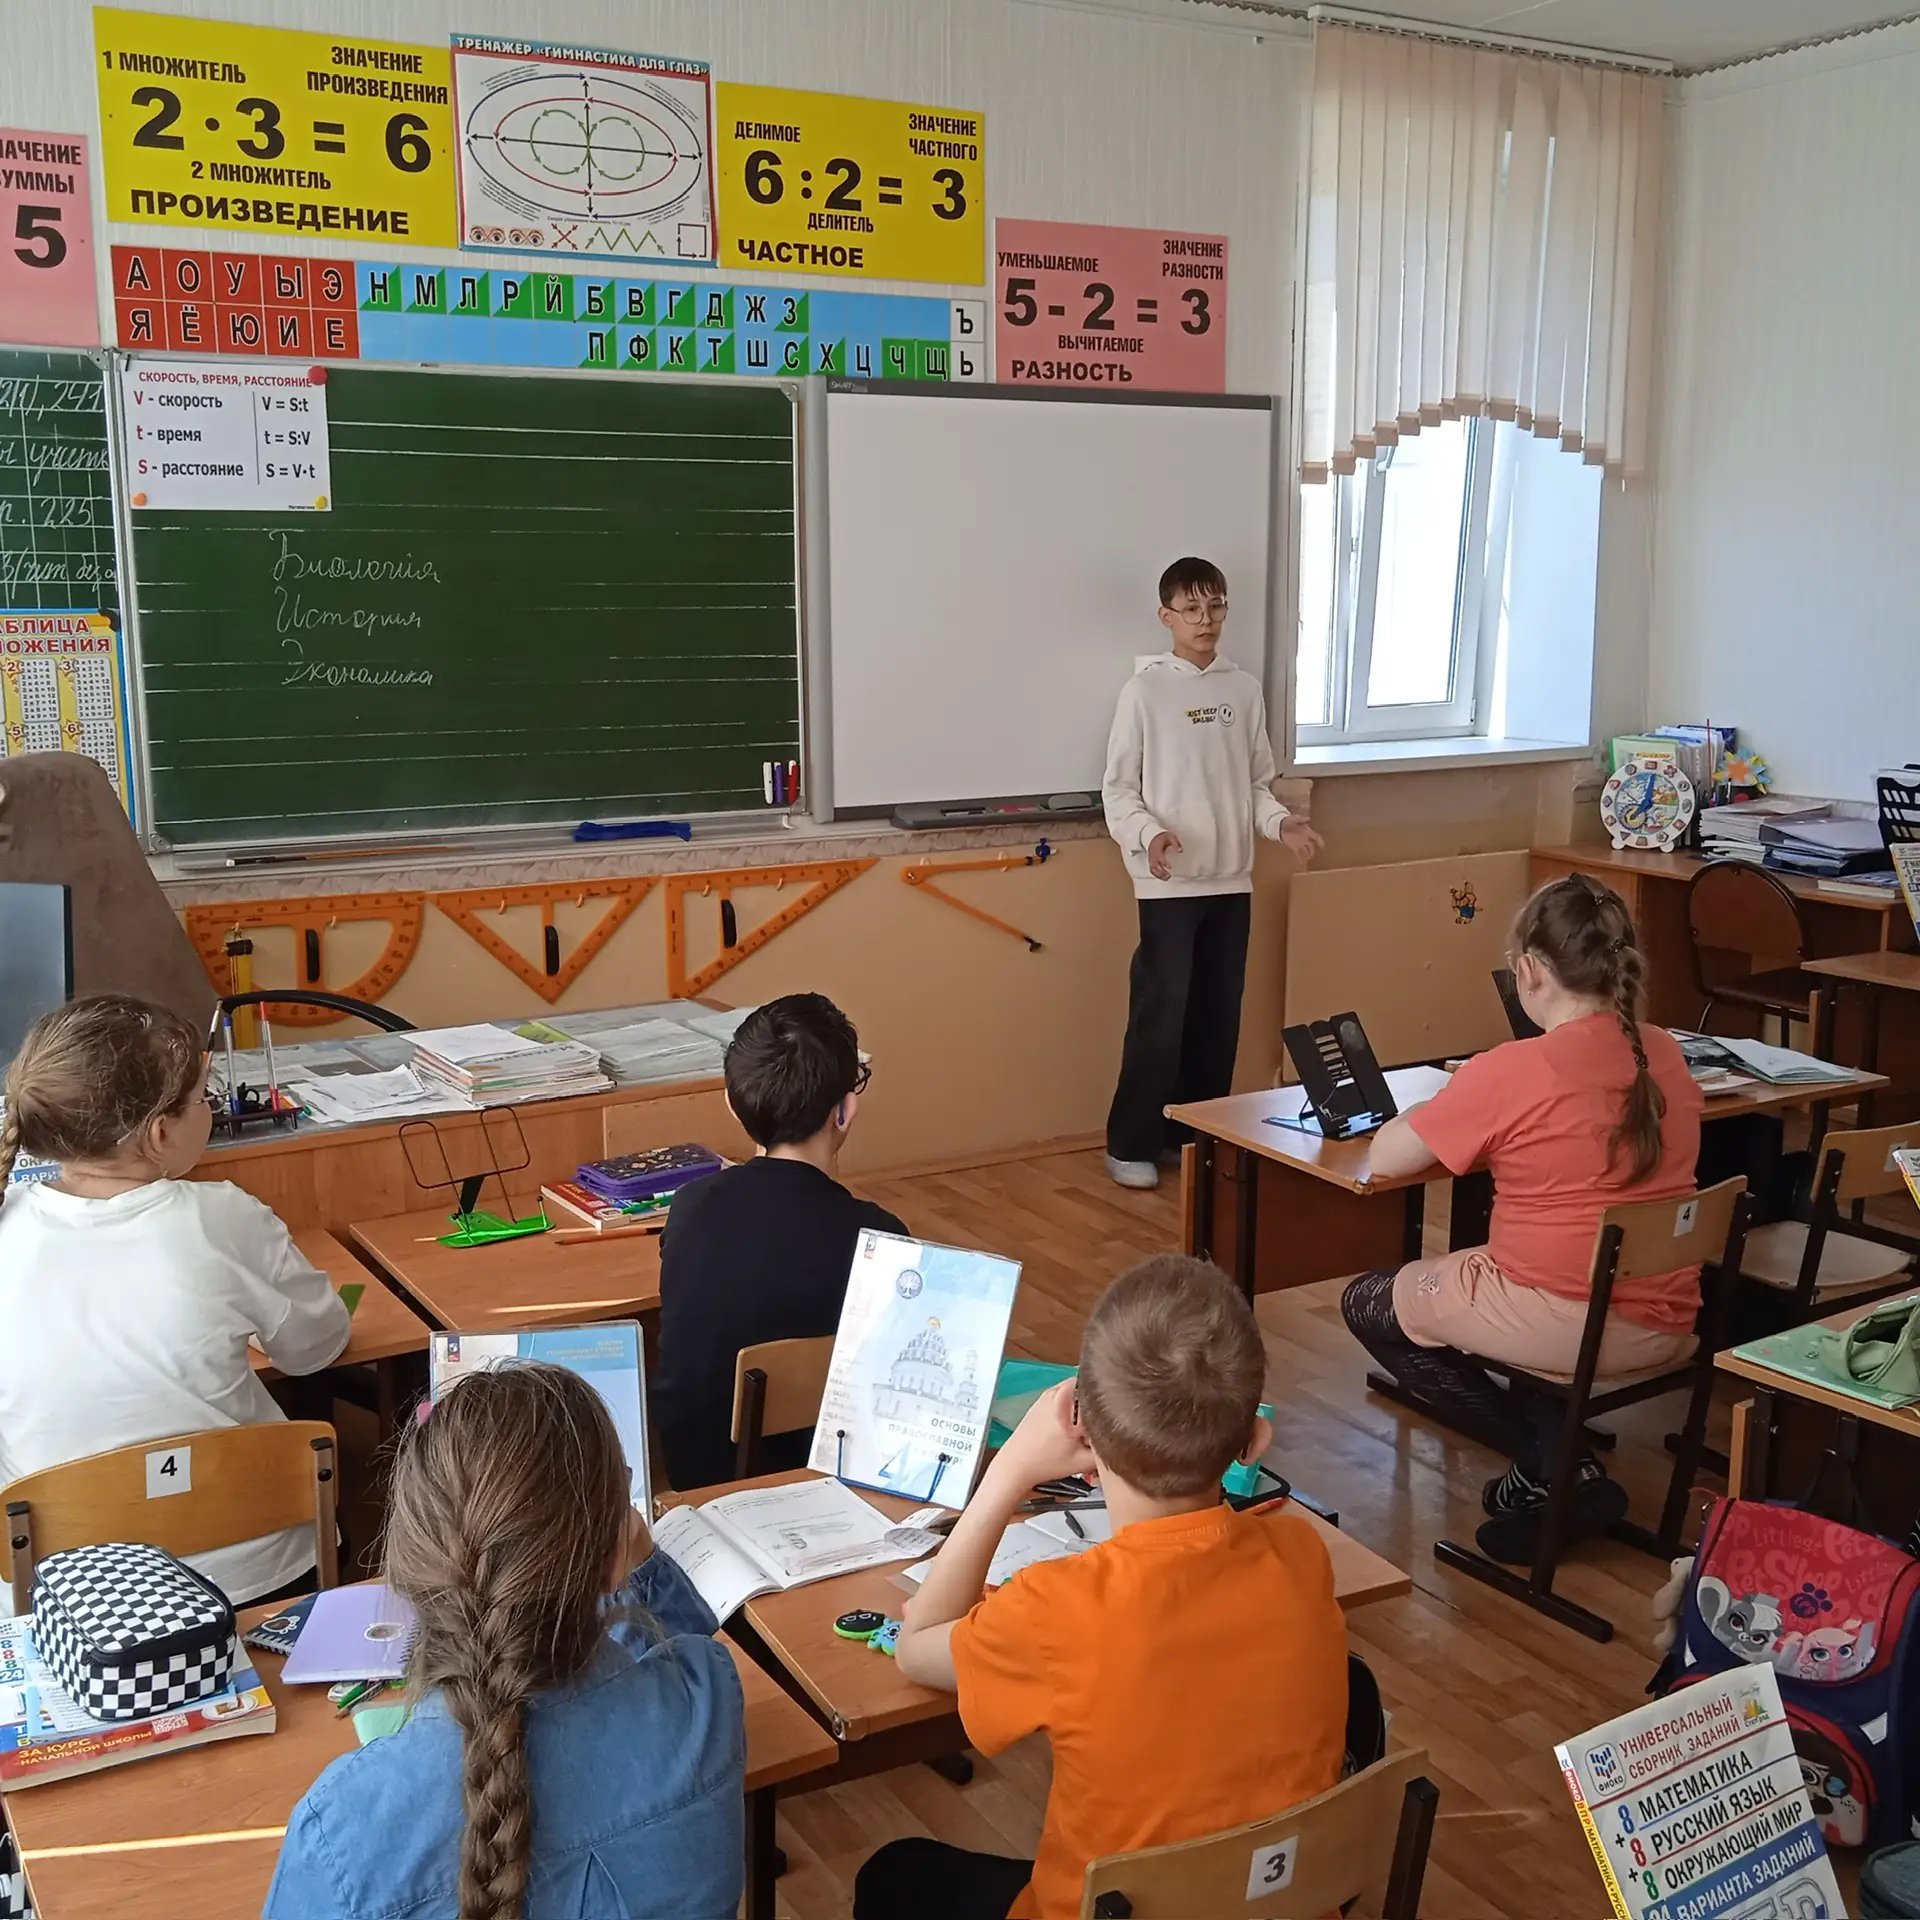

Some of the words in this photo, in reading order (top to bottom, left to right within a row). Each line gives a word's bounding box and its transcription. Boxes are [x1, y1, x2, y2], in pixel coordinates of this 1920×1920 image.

[103, 51, 112, 69] 1
[119, 52, 246, 83] МНОЖИТЕЛЬ
[332, 46, 422, 73] ЗНАЧЕНИЕ
[639, 57, 666, 71] ДЛЯ
[307, 71, 447, 104] ПРОИЗВЕДЕНИЯ
[132, 87, 184, 150] 2
[236, 98, 284, 159] 3
[386, 113, 431, 172] 6
[735, 121, 800, 142] ДЕЛИМОЕ
[909, 113, 976, 136] ЗНАЧЕНИЕ
[909, 138, 977, 160] ЧАСТНОГО
[0, 169, 74, 194] УММЫ
[191, 161, 204, 179] 2
[210, 163, 331, 189] МНОЖИТЕЛЬ
[745, 150, 783, 204] 6
[825, 159, 861, 211] 2
[932, 169, 966, 220] 3
[131, 190, 409, 234] ПРОИЗВЕДЕНИЕ
[808, 213, 873, 232] ДЕЛИТЕЛЬ
[14, 205, 66, 268] 5
[739, 239, 863, 268] ЧАСТНОЕ
[1164, 240, 1222, 258] ЗНАЧЕНИЕ
[998, 252, 1098, 272] УМЕНЬШАЕМОЕ
[1163, 262, 1223, 280] РАЗНОСТИ
[127, 255, 150, 290] А
[178, 259, 199, 292] О
[223, 262, 246, 295] У
[275, 265, 302, 298] Ы
[322, 269, 344, 300] Э
[370, 271, 389, 304] Н
[414, 274, 436, 306] М
[459, 277, 477, 308] Л
[502, 280, 519, 310] Р
[544, 275, 562, 314] Й
[587, 285, 604, 314] Б
[628, 288, 644, 317] В
[668, 289, 681, 318] Г
[707, 293, 724, 327] Д
[745, 294, 766, 323] Ж
[782, 297, 797, 325] З
[956, 308, 973, 335] Ъ
[1004, 278, 1037, 326] 5
[1083, 283, 1114, 330] 2
[1181, 289, 1210, 335] 3
[130, 310, 152, 340] Я
[182, 306, 201, 342] Ё
[231, 312, 259, 345] Ю
[279, 317, 298, 348] И
[326, 319, 346, 349] Е
[588, 332, 605, 361] П
[628, 335, 649, 362] Ф
[668, 338, 684, 364] К
[707, 338, 722, 366] Т
[746, 340, 768, 367] Ш
[783, 341, 799, 369] С
[820, 342, 834, 371] Х
[856, 344, 871, 379] Ц
[890, 344, 905, 373] Ч
[924, 347, 947, 380] Щ
[960, 350, 974, 375] Ь
[1059, 335, 1143, 352] ВЫЧИТАЕМОЕ
[139, 371, 199, 386] СКОРОСТЬ,
[202, 374, 242, 387] ВРЕМЯ,
[244, 376, 313, 388] РАССТОЯНИЕ
[1012, 360, 1132, 381] РАЗНОСТЬ
[133, 391, 144, 405] V
[158, 394, 223, 410] скорость
[261, 397, 272, 411] V
[136, 425, 143, 440] t
[157, 428, 202, 444] время
[264, 430, 271, 445] t
[138, 459, 148, 475] S
[162, 461, 244, 479] расстояние
[266, 463, 275, 478] S
[40, 497, 92, 529] 225
[274, 585, 421, 636] История
[0, 618, 90, 636] БЛИЦА
[0, 638, 110, 654] ОЖЕНИЯ
[7, 661, 16, 672] 2
[63, 660, 71, 671] 3
[281, 638, 434, 686] Экономика
[13, 726, 21, 737] 5
[67, 723, 76, 734] 6
[1682, 1206, 1691, 1221] 4
[931, 1418, 976, 1437] ОСНОВЫ
[160, 1455, 178, 1478] 4
[1619, 1693, 1734, 1759] УНИВЕРСАЛЬНЫЙ
[19, 1748, 42, 1758] ЗА
[46, 1738, 92, 1754] КУРС
[20, 1744, 101, 1766] НАЧАЛЬНОЙ
[103, 1731, 153, 1748] ШКОЛЫ
[1628, 1743, 1684, 1780] СБОРНИК
[1686, 1715, 1741, 1751] ЗАДАНИЙ
[1598, 1774, 1624, 1792] ФИОКО
[1617, 1803, 1635, 1835] 8
[1638, 1750, 1754, 1823] МАТЕМАТИКА
[1629, 1837, 1647, 1867] 8
[1651, 1794, 1728, 1856] РУССКИЙ
[1730, 1775, 1779, 1814] ЯЗЫК
[1586, 1827, 1615, 1888] МАТЕМАТИКА
[1642, 1869, 1660, 1900] 8
[1664, 1813, 1773, 1889] ОКРУЖАЮЩИЙ
[1773, 1800, 1804, 1833] МИР
[1263, 1852, 1287, 1884] 3
[1677, 1871, 1755, 1920] ВАРИАНТА
[1752, 1834, 1818, 1884] ЗАДАНИЙ
